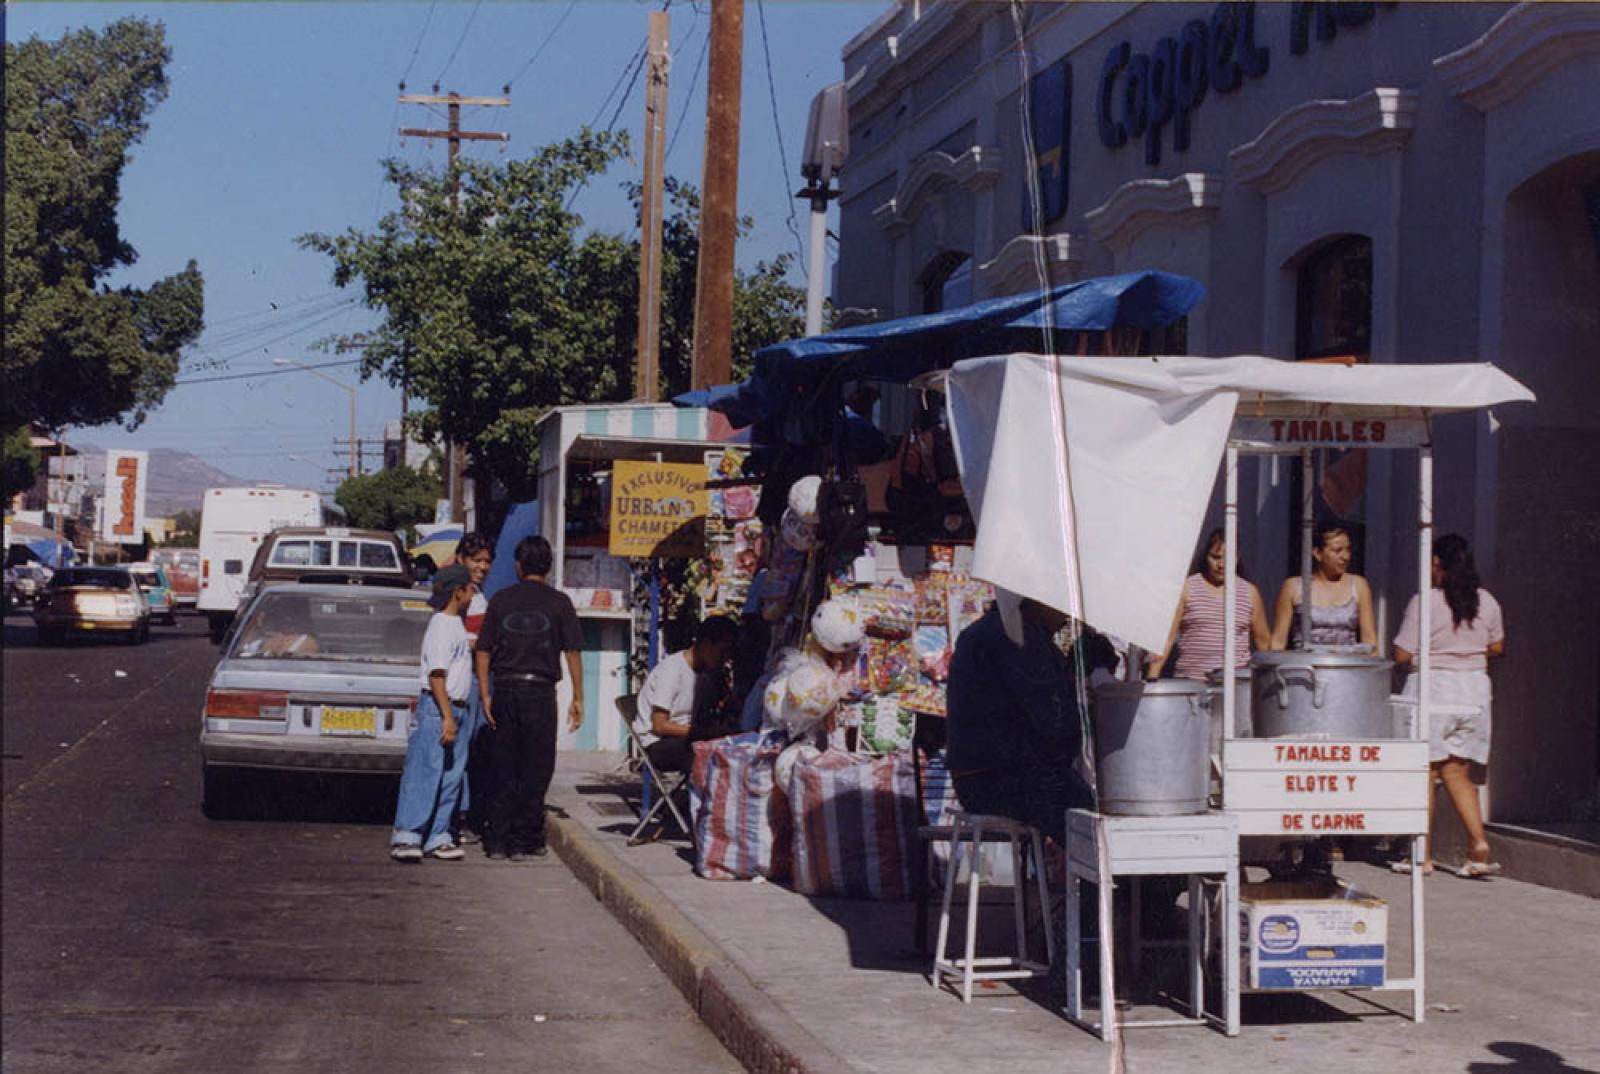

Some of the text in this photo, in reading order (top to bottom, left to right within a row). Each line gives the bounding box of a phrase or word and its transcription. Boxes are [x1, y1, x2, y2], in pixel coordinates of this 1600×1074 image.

[1097, 2, 1270, 166] Coppel
[1270, 418, 1387, 442] TAMALES
[1274, 745, 1381, 762] TAMALES DE
[1285, 775, 1357, 792] ELOTE Y
[1282, 813, 1366, 830] DE CARNE
